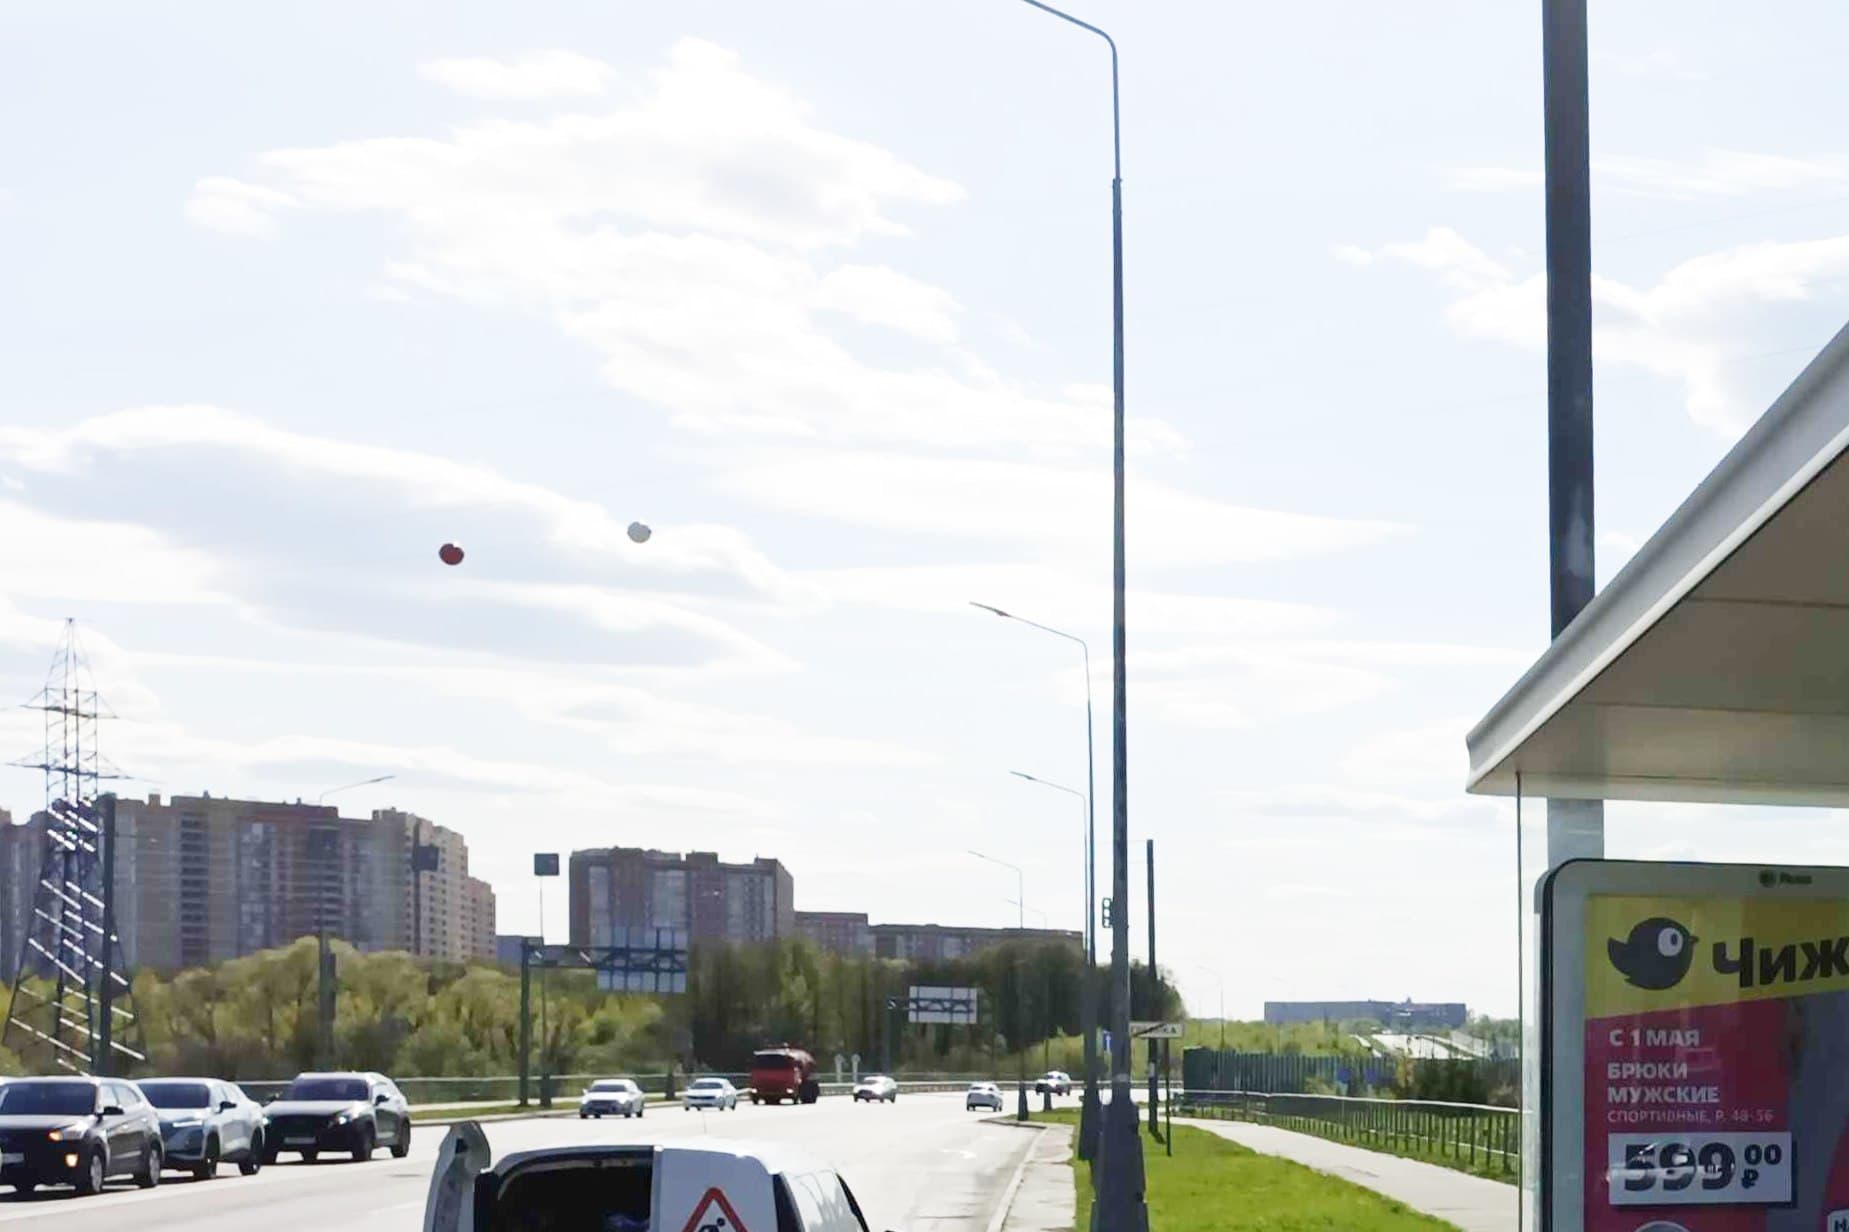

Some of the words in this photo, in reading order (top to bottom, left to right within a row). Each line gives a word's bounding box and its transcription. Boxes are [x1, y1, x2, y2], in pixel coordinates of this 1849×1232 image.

[1609, 1028, 1624, 1047] С
[1630, 1028, 1641, 1047] 1
[1645, 1028, 1700, 1047] МАЯ
[1607, 1061, 1689, 1080] БРЮКИ
[1607, 1085, 1721, 1105] МУЖСКИЕ
[1623, 1141, 1736, 1192] 599
